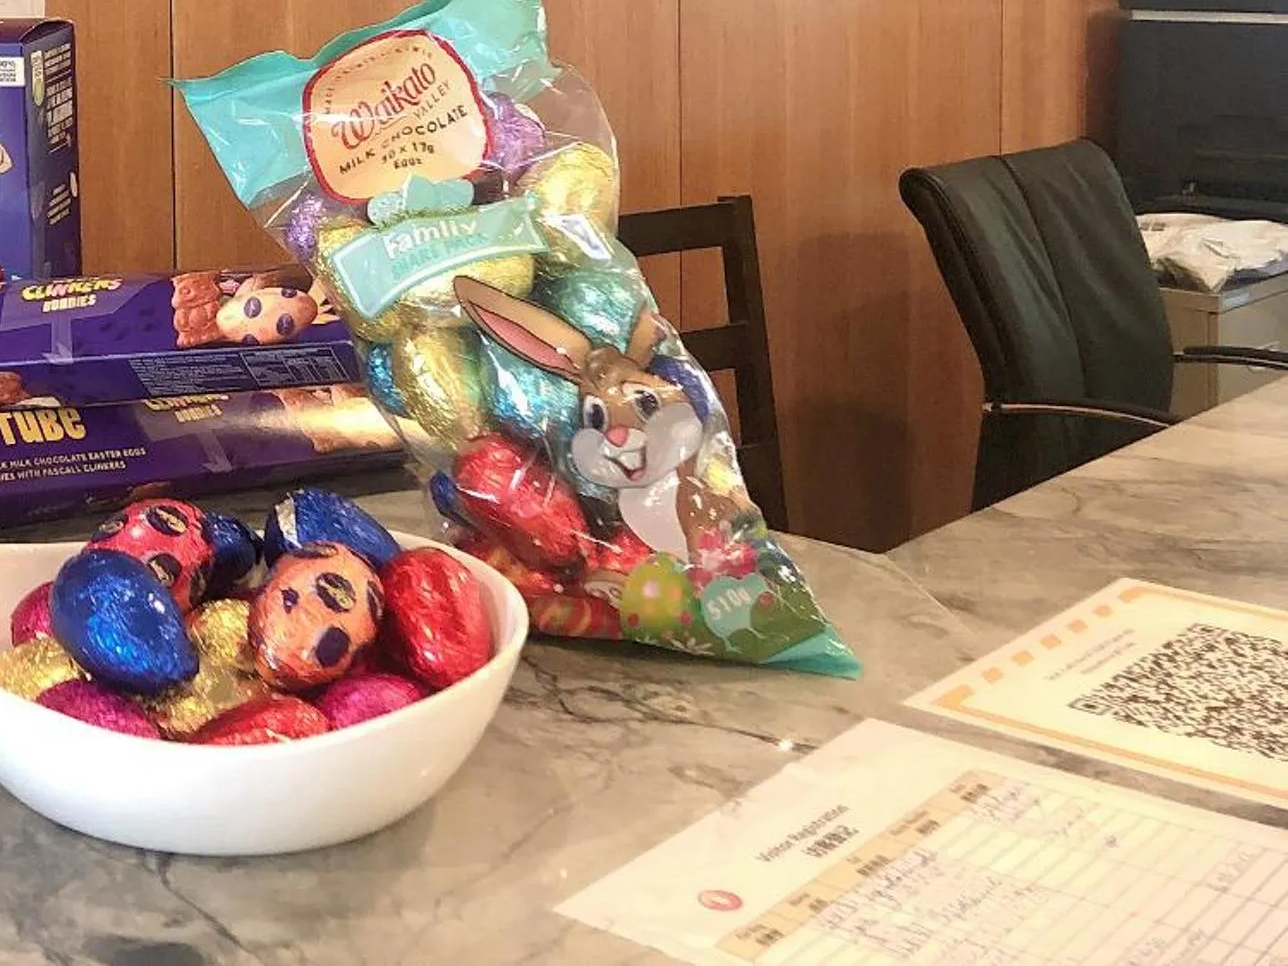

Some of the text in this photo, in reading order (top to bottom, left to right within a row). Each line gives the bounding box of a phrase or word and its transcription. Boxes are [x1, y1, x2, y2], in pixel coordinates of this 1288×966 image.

[331, 62, 436, 150] Waikato
[414, 80, 451, 120] VALLEY
[339, 105, 468, 175] MILK CHOCOLATE
[413, 141, 435, 155] 17g
[10, 459, 32, 469] MILK
[33, 453, 87, 466] CHOCOLATE
[88, 450, 121, 461] EASTER
[123, 447, 147, 457] EGGS
[16, 469, 41, 480] WITH
[42, 465, 81, 477] PASCALL
[83, 461, 126, 473] CLINKERS
[786, 804, 849, 842] Registration
